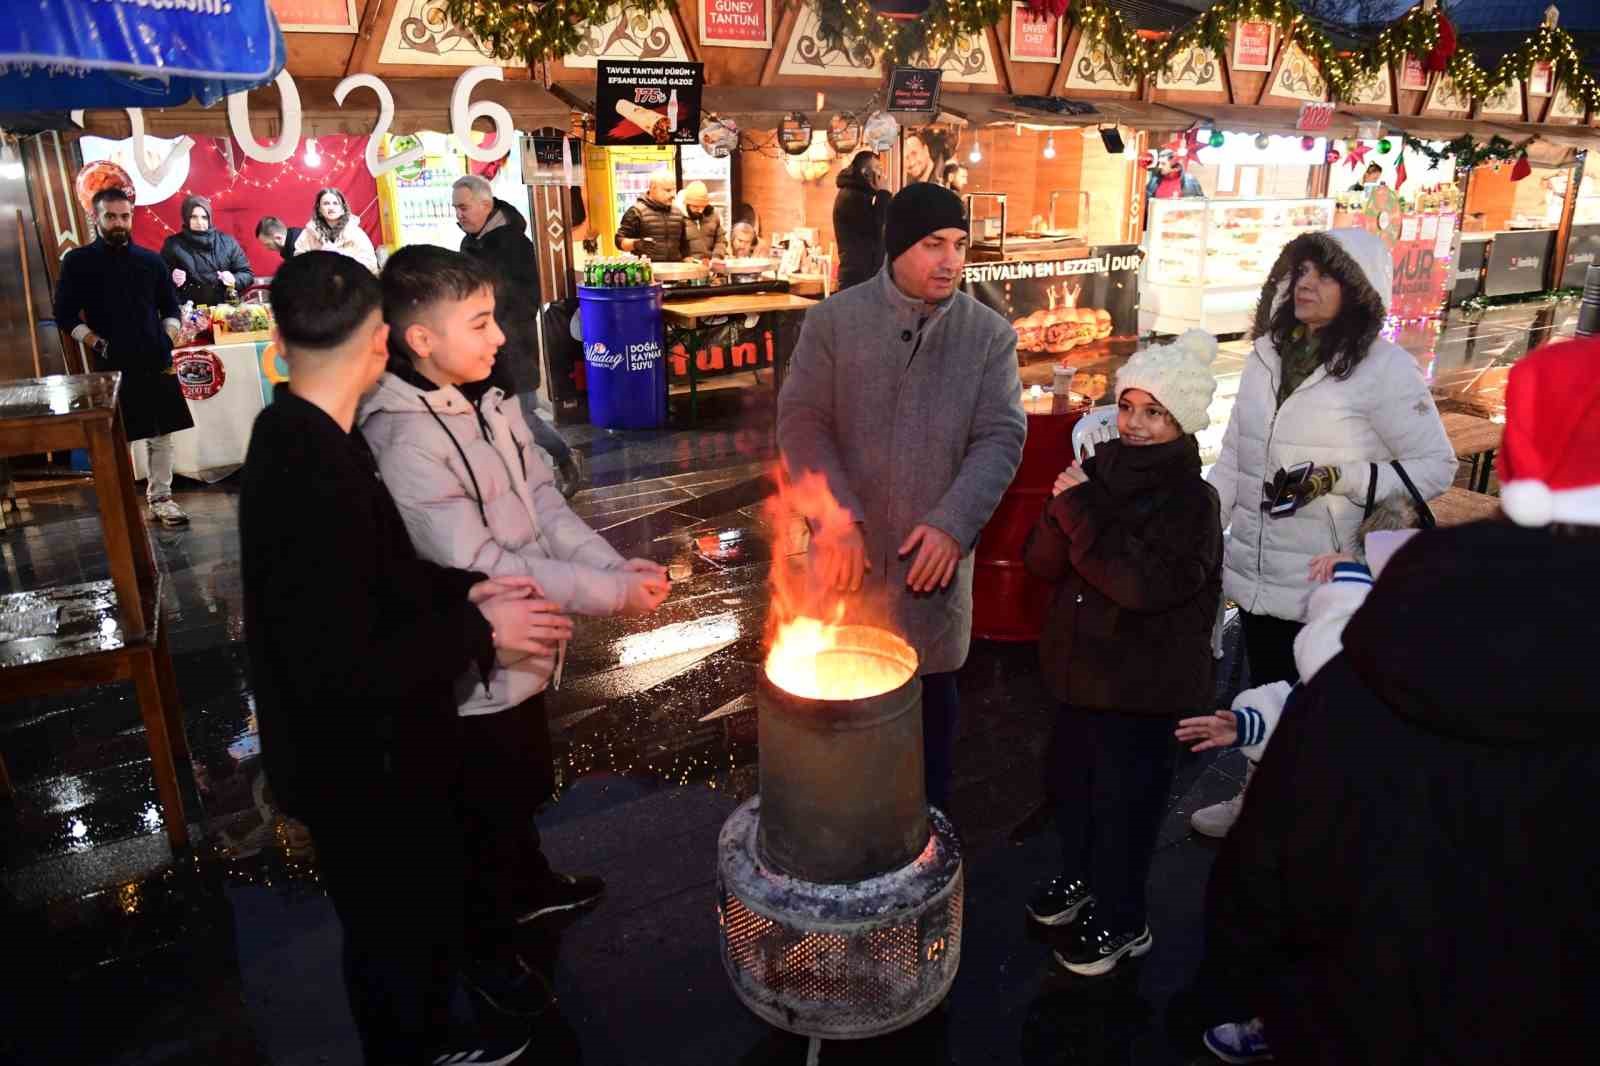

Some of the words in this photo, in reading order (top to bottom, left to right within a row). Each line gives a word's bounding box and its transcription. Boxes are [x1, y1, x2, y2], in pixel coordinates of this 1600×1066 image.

[709, 12, 759, 26] TANTUNİ
[606, 66, 631, 74] TAVUK
[632, 67, 664, 75] TANTUNİ
[664, 67, 690, 76] DÜRÜM
[608, 77, 637, 85] EFSANE
[638, 76, 667, 85] ULUDAĞ
[669, 78, 694, 86] GAZOZ
[962, 261, 1033, 283] ESTİVALİN
[1034, 262, 1053, 277] EN
[1056, 253, 1111, 275] LEZZETLİ
[630, 341, 659, 353] DOĞAL
[630, 349, 662, 362] KAYNAK
[631, 360, 653, 371] SUYU
